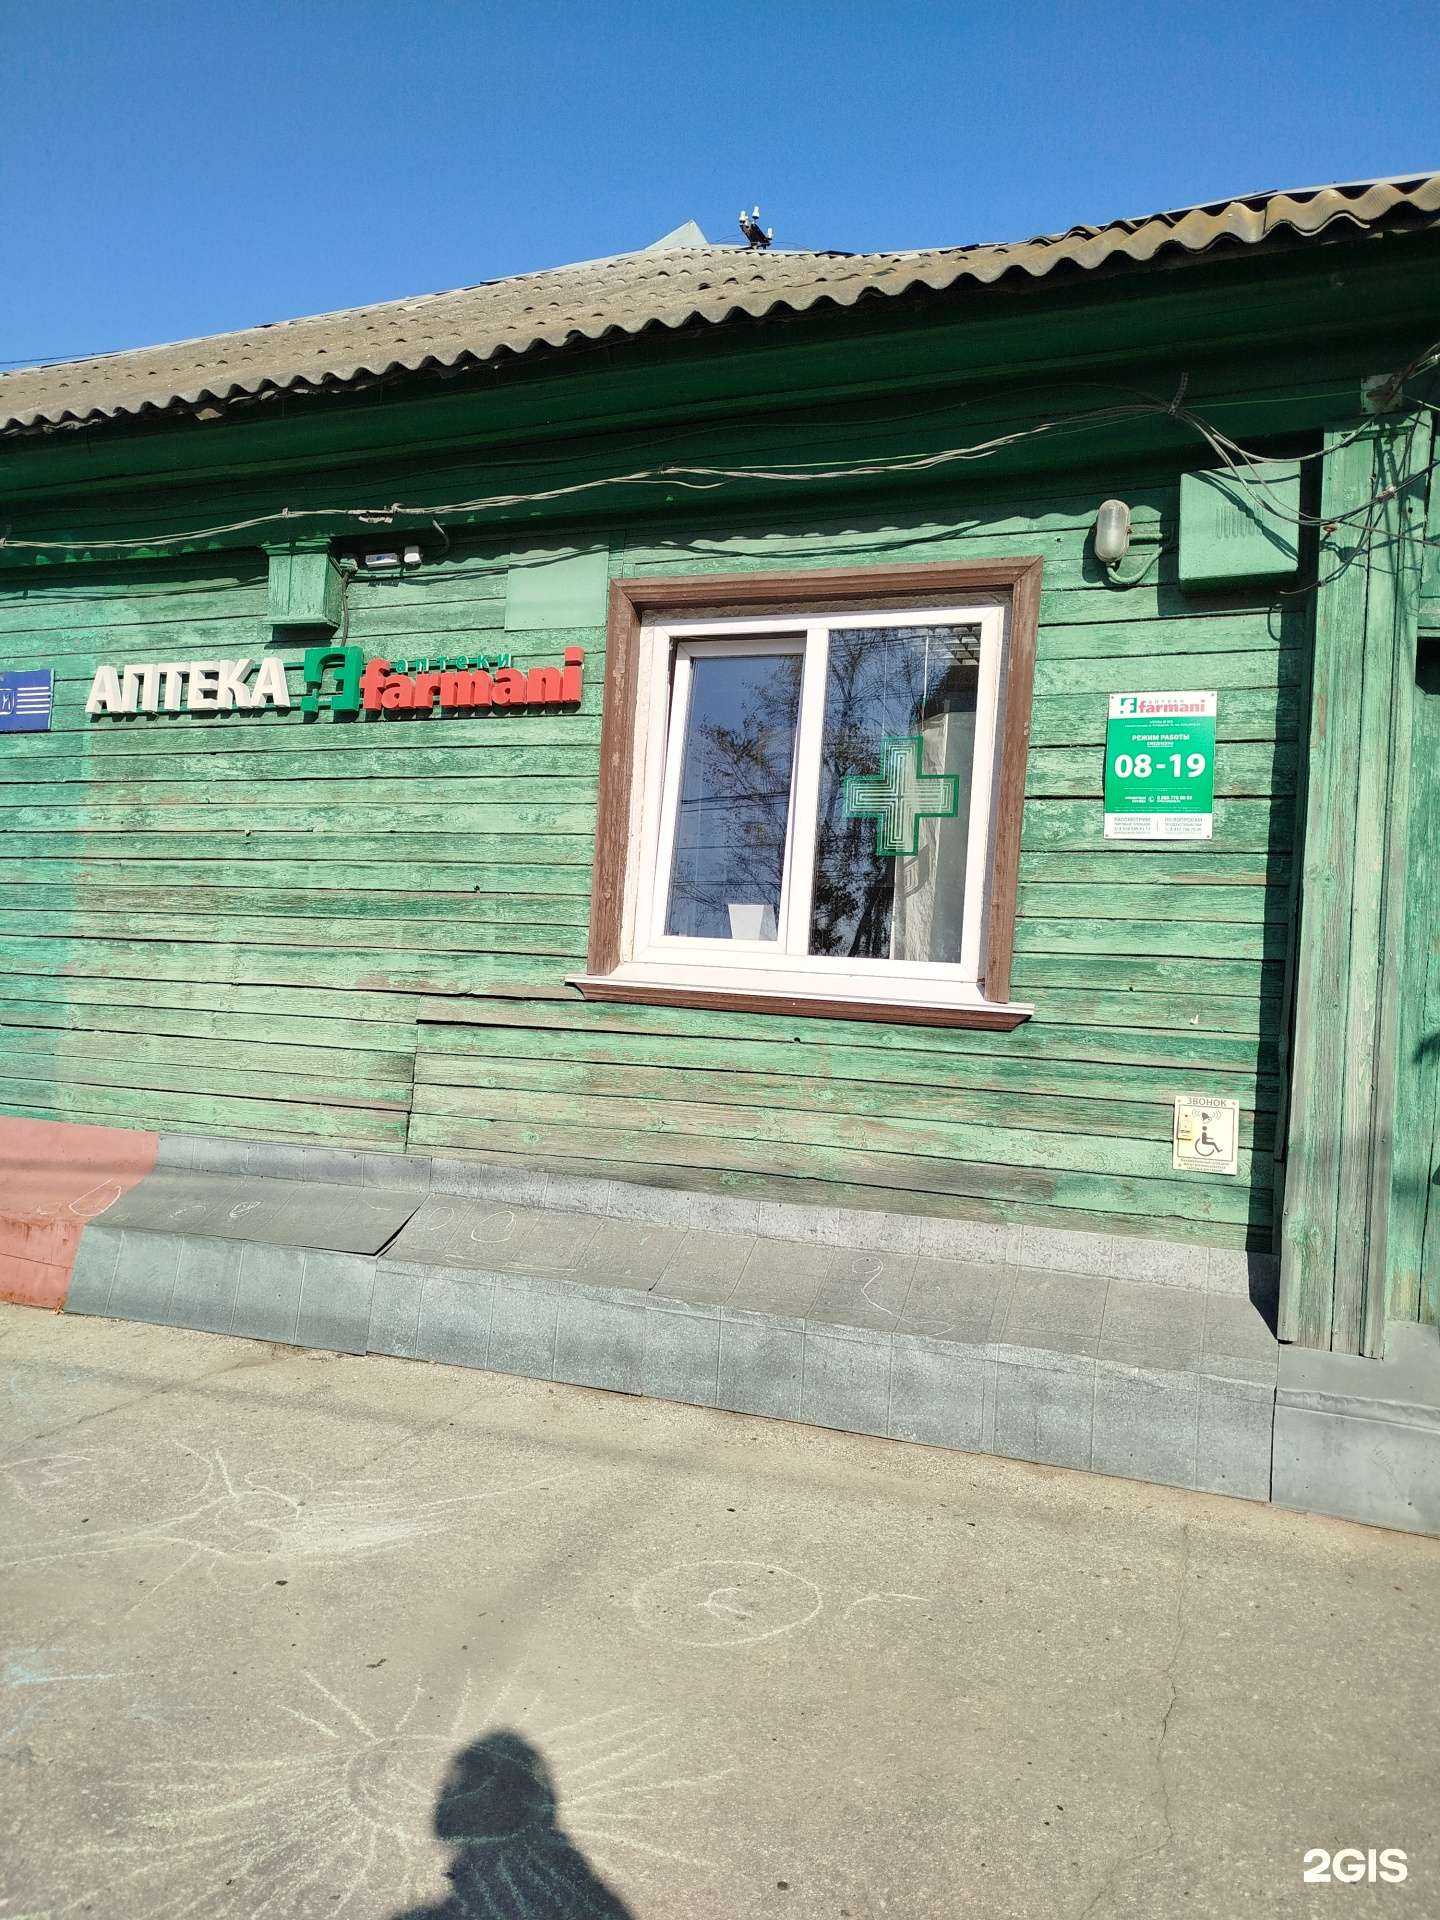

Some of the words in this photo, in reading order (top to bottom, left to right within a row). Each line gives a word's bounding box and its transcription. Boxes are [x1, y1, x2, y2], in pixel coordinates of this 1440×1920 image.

[395, 653, 512, 674] аптеки
[86, 657, 290, 713] АПТЕКА
[359, 646, 585, 712] farmani
[1139, 699, 1206, 713] farmani
[1131, 734, 1160, 742] РЕЖИМ
[1160, 733, 1190, 741] РАБОТЫ
[1187, 1097, 1227, 1107] ЗВОНОК
